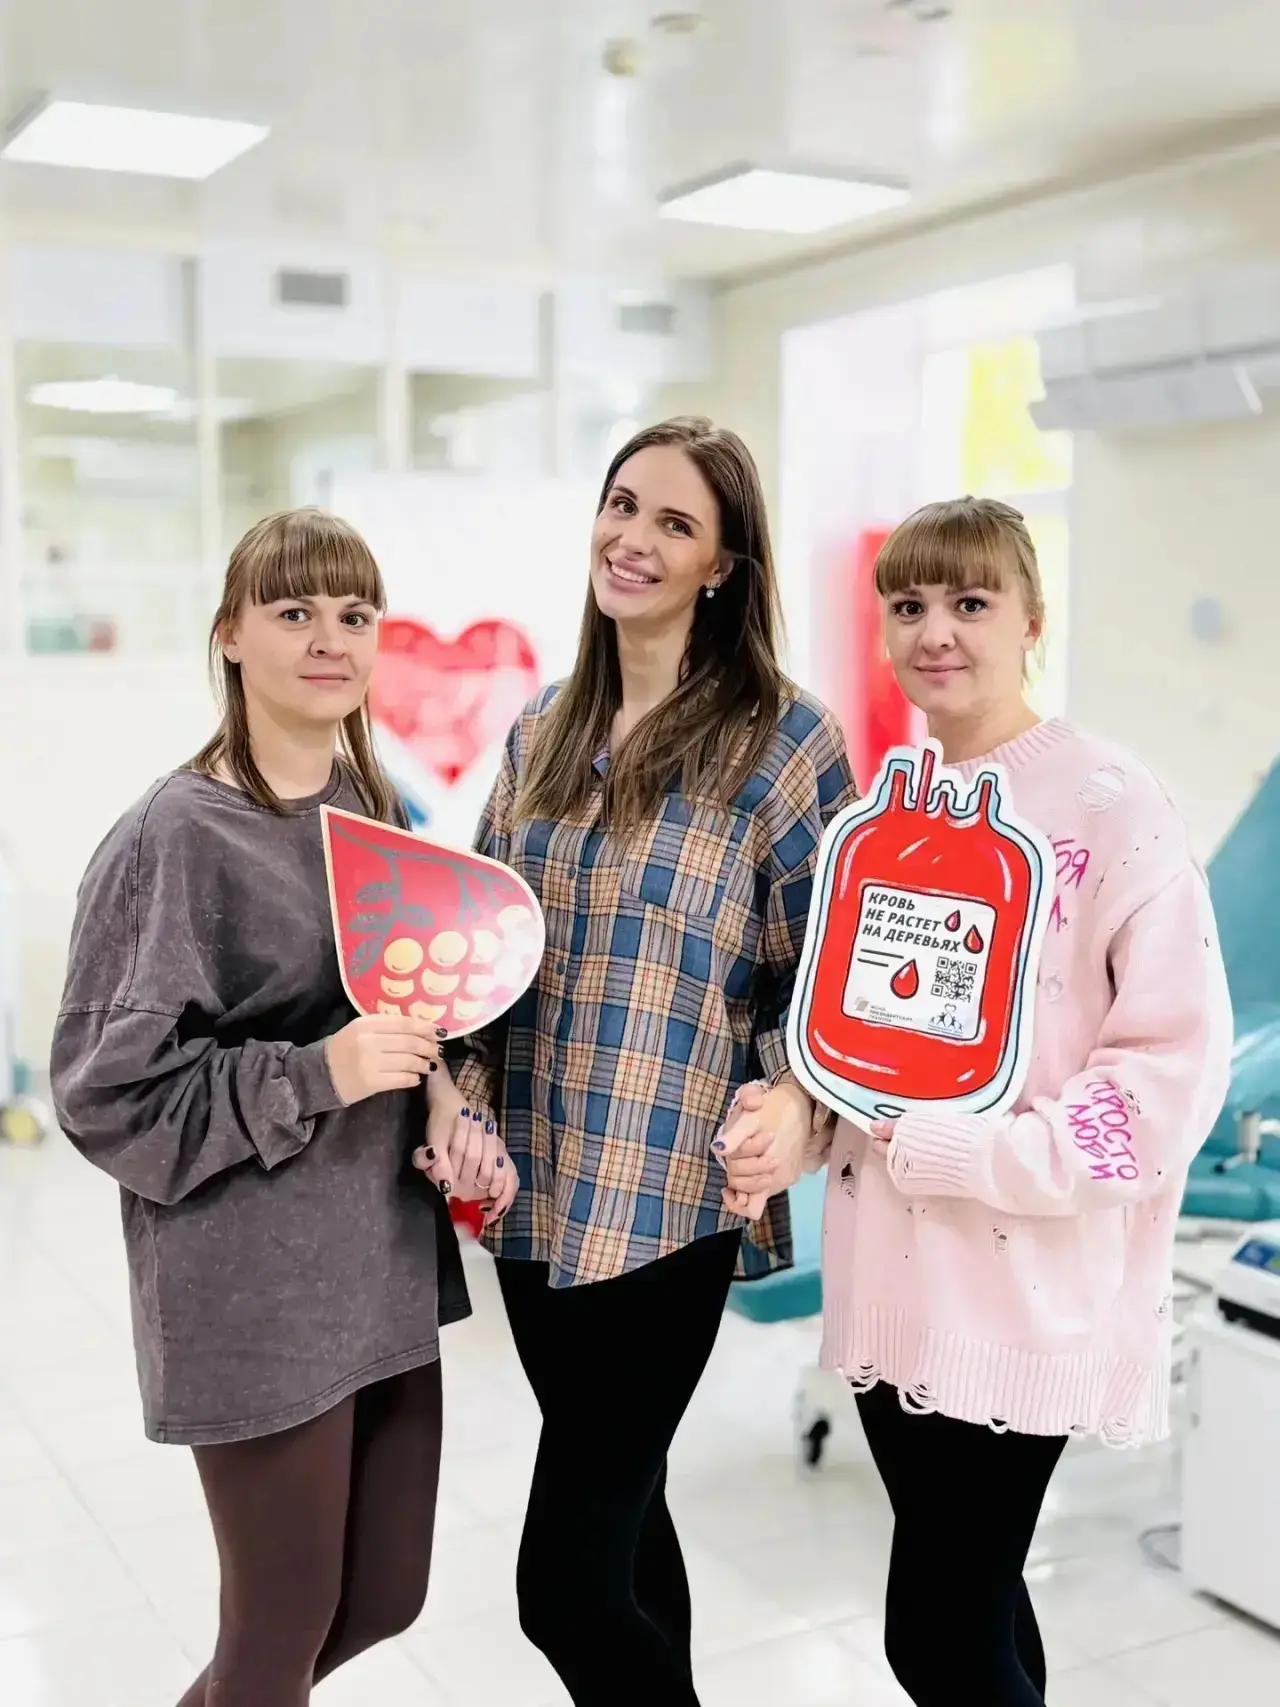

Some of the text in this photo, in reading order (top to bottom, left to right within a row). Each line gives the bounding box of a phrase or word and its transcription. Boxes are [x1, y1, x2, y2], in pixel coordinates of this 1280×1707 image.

[868, 892, 916, 911] КРОВЬ
[865, 908, 942, 932] НЕ РАСТЕТ
[862, 923, 961, 953] НА ДЕРЕВЬЯХ
[1065, 1104, 1116, 1180] ЛЮБИ
[1085, 1080, 1139, 1180] ПРОСТО
